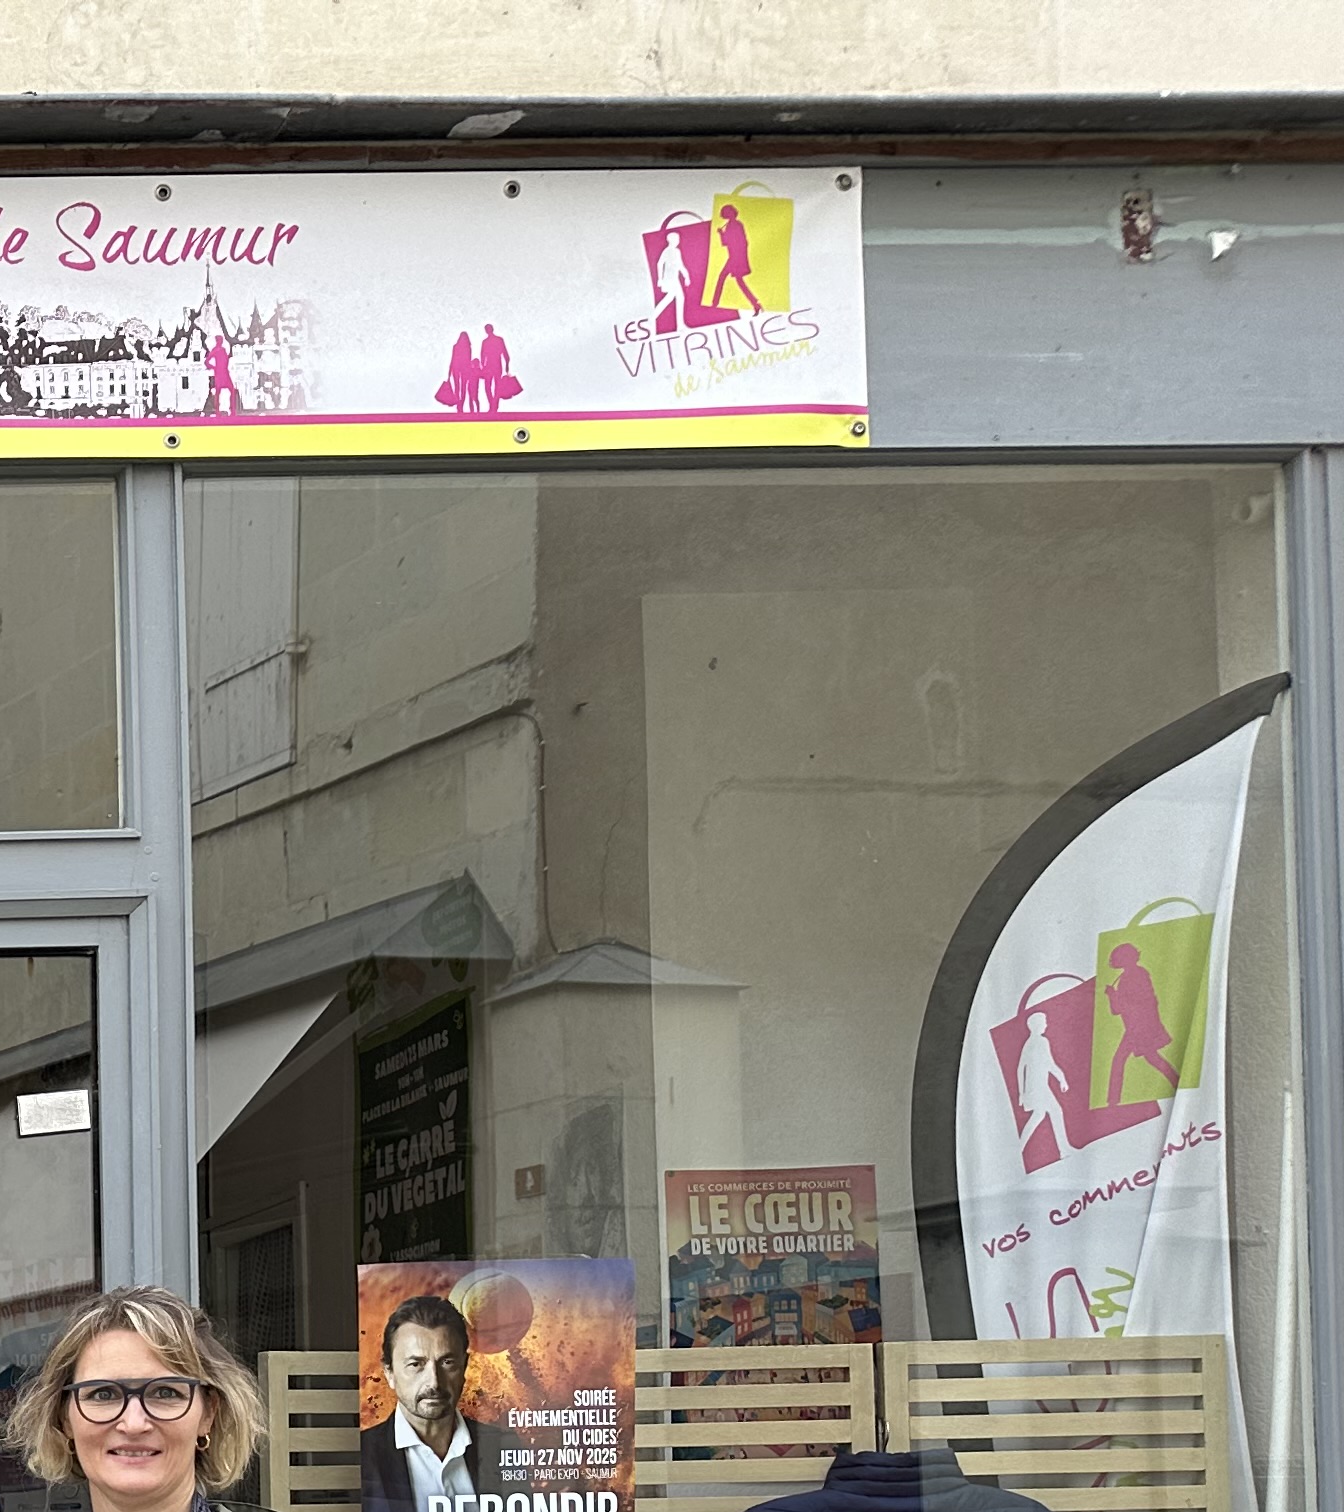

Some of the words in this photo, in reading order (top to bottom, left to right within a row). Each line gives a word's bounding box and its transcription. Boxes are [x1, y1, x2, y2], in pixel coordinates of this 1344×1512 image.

[55, 201, 301, 272] Saumur
[613, 318, 651, 345] LES
[615, 308, 820, 378] VITRINES
[673, 372, 701, 399] de
[687, 1184, 706, 1193] LES
[708, 1182, 776, 1192] COMMERCES
[777, 1181, 792, 1191] DE
[689, 1194, 732, 1235] LE
[690, 1237, 711, 1256] DE
[715, 1235, 768, 1255] VOTRE
[773, 1233, 855, 1253] QUARTIER
[982, 1223, 1031, 1258] vos
[574, 1387, 616, 1406] SOIRÉE
[563, 1429, 580, 1446] DU
[582, 1428, 617, 1445] CIDES
[499, 1449, 534, 1466] JEUDI
[537, 1449, 554, 1466] 27
[557, 1448, 583, 1465] NOV
[586, 1448, 617, 1465] 2025
[534, 1468, 557, 1480] PARC
[557, 1468, 579, 1480] EXPO
